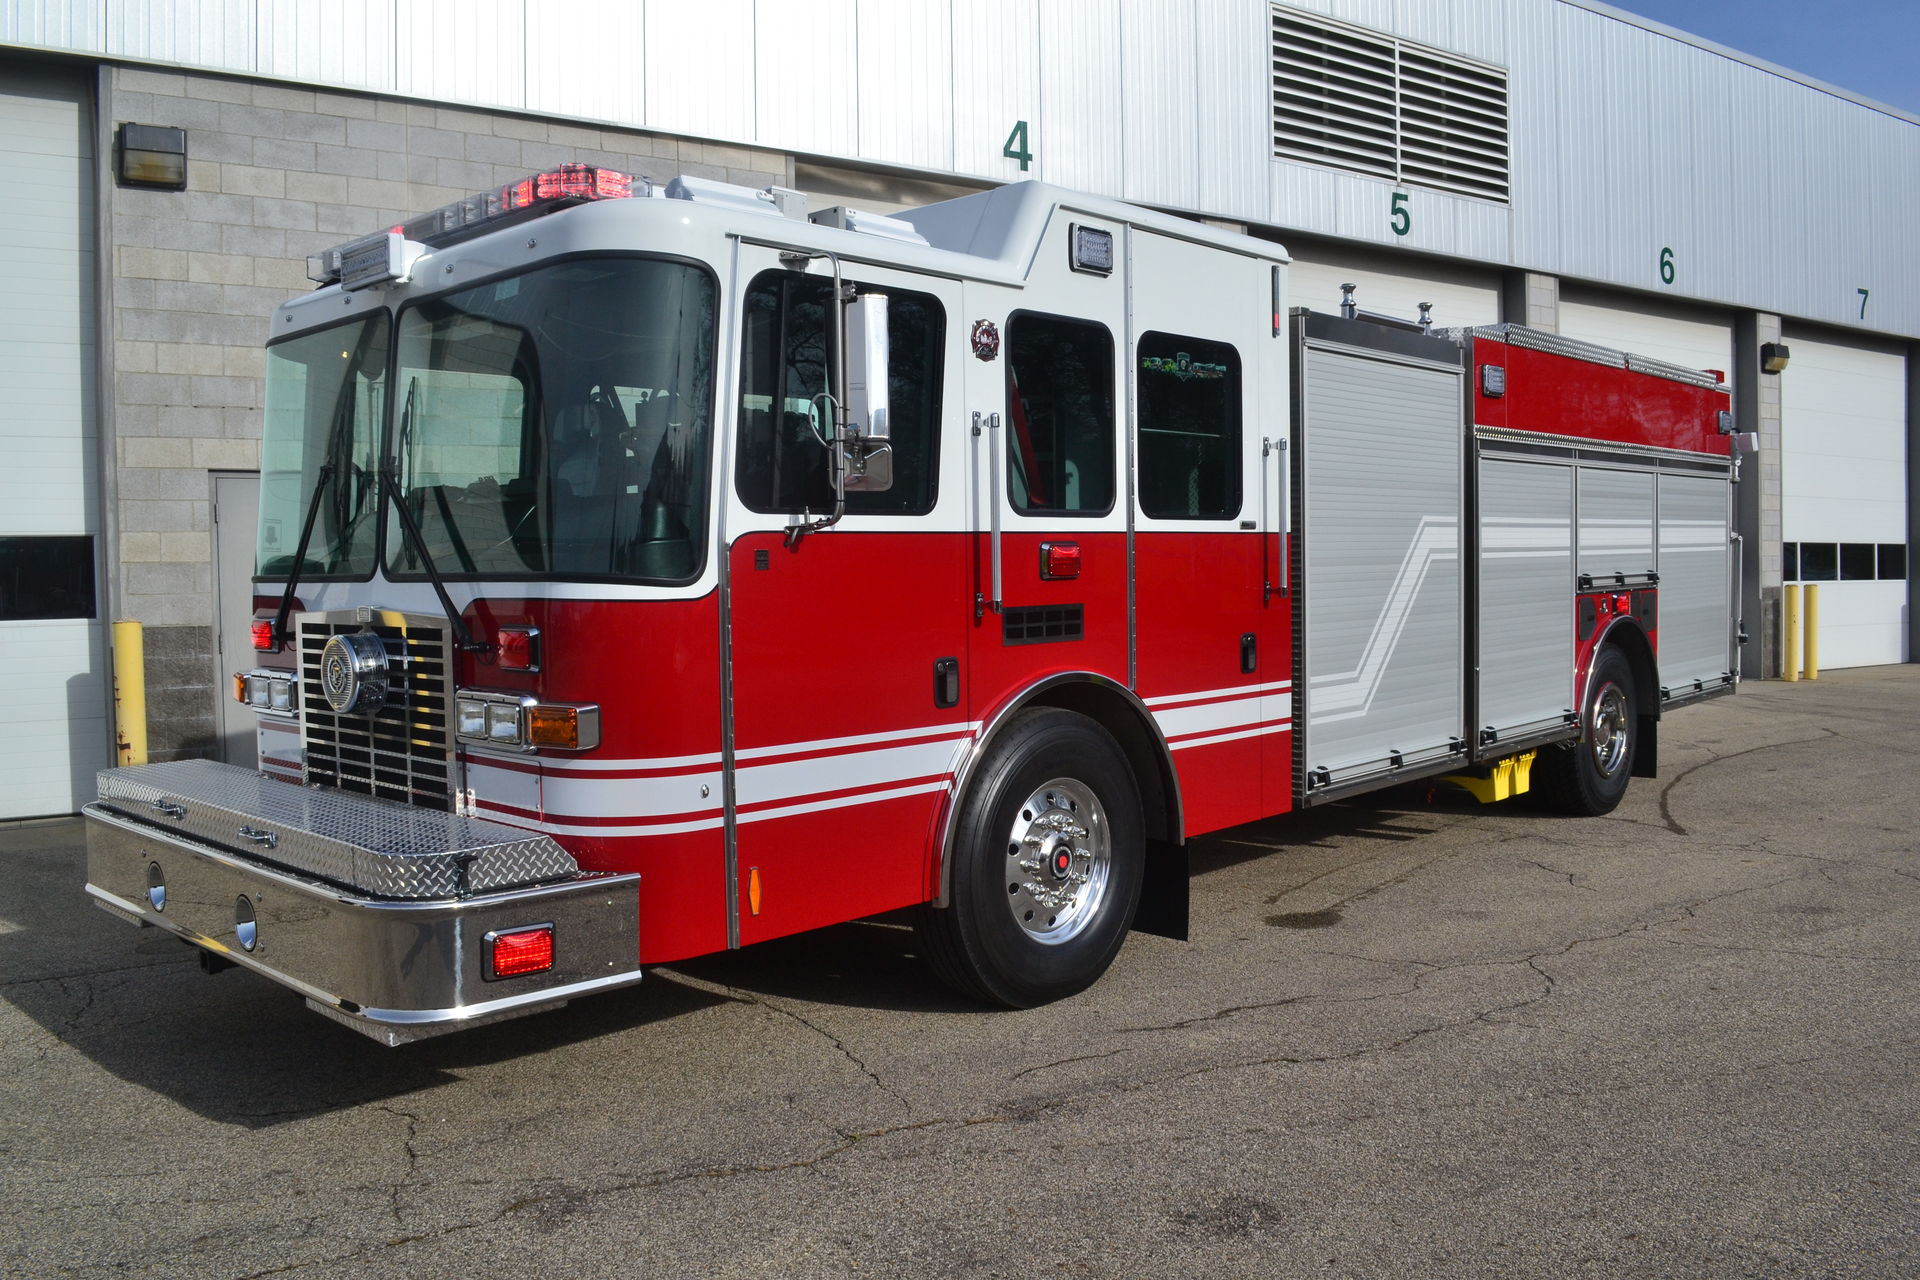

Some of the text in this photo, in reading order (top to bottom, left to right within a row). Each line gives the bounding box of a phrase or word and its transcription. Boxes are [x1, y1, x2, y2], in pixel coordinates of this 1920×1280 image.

[1004, 120, 1032, 171] 4
[1391, 192, 1410, 236] 5
[1660, 247, 1675, 285] 6
[1858, 288, 1868, 319] 7
